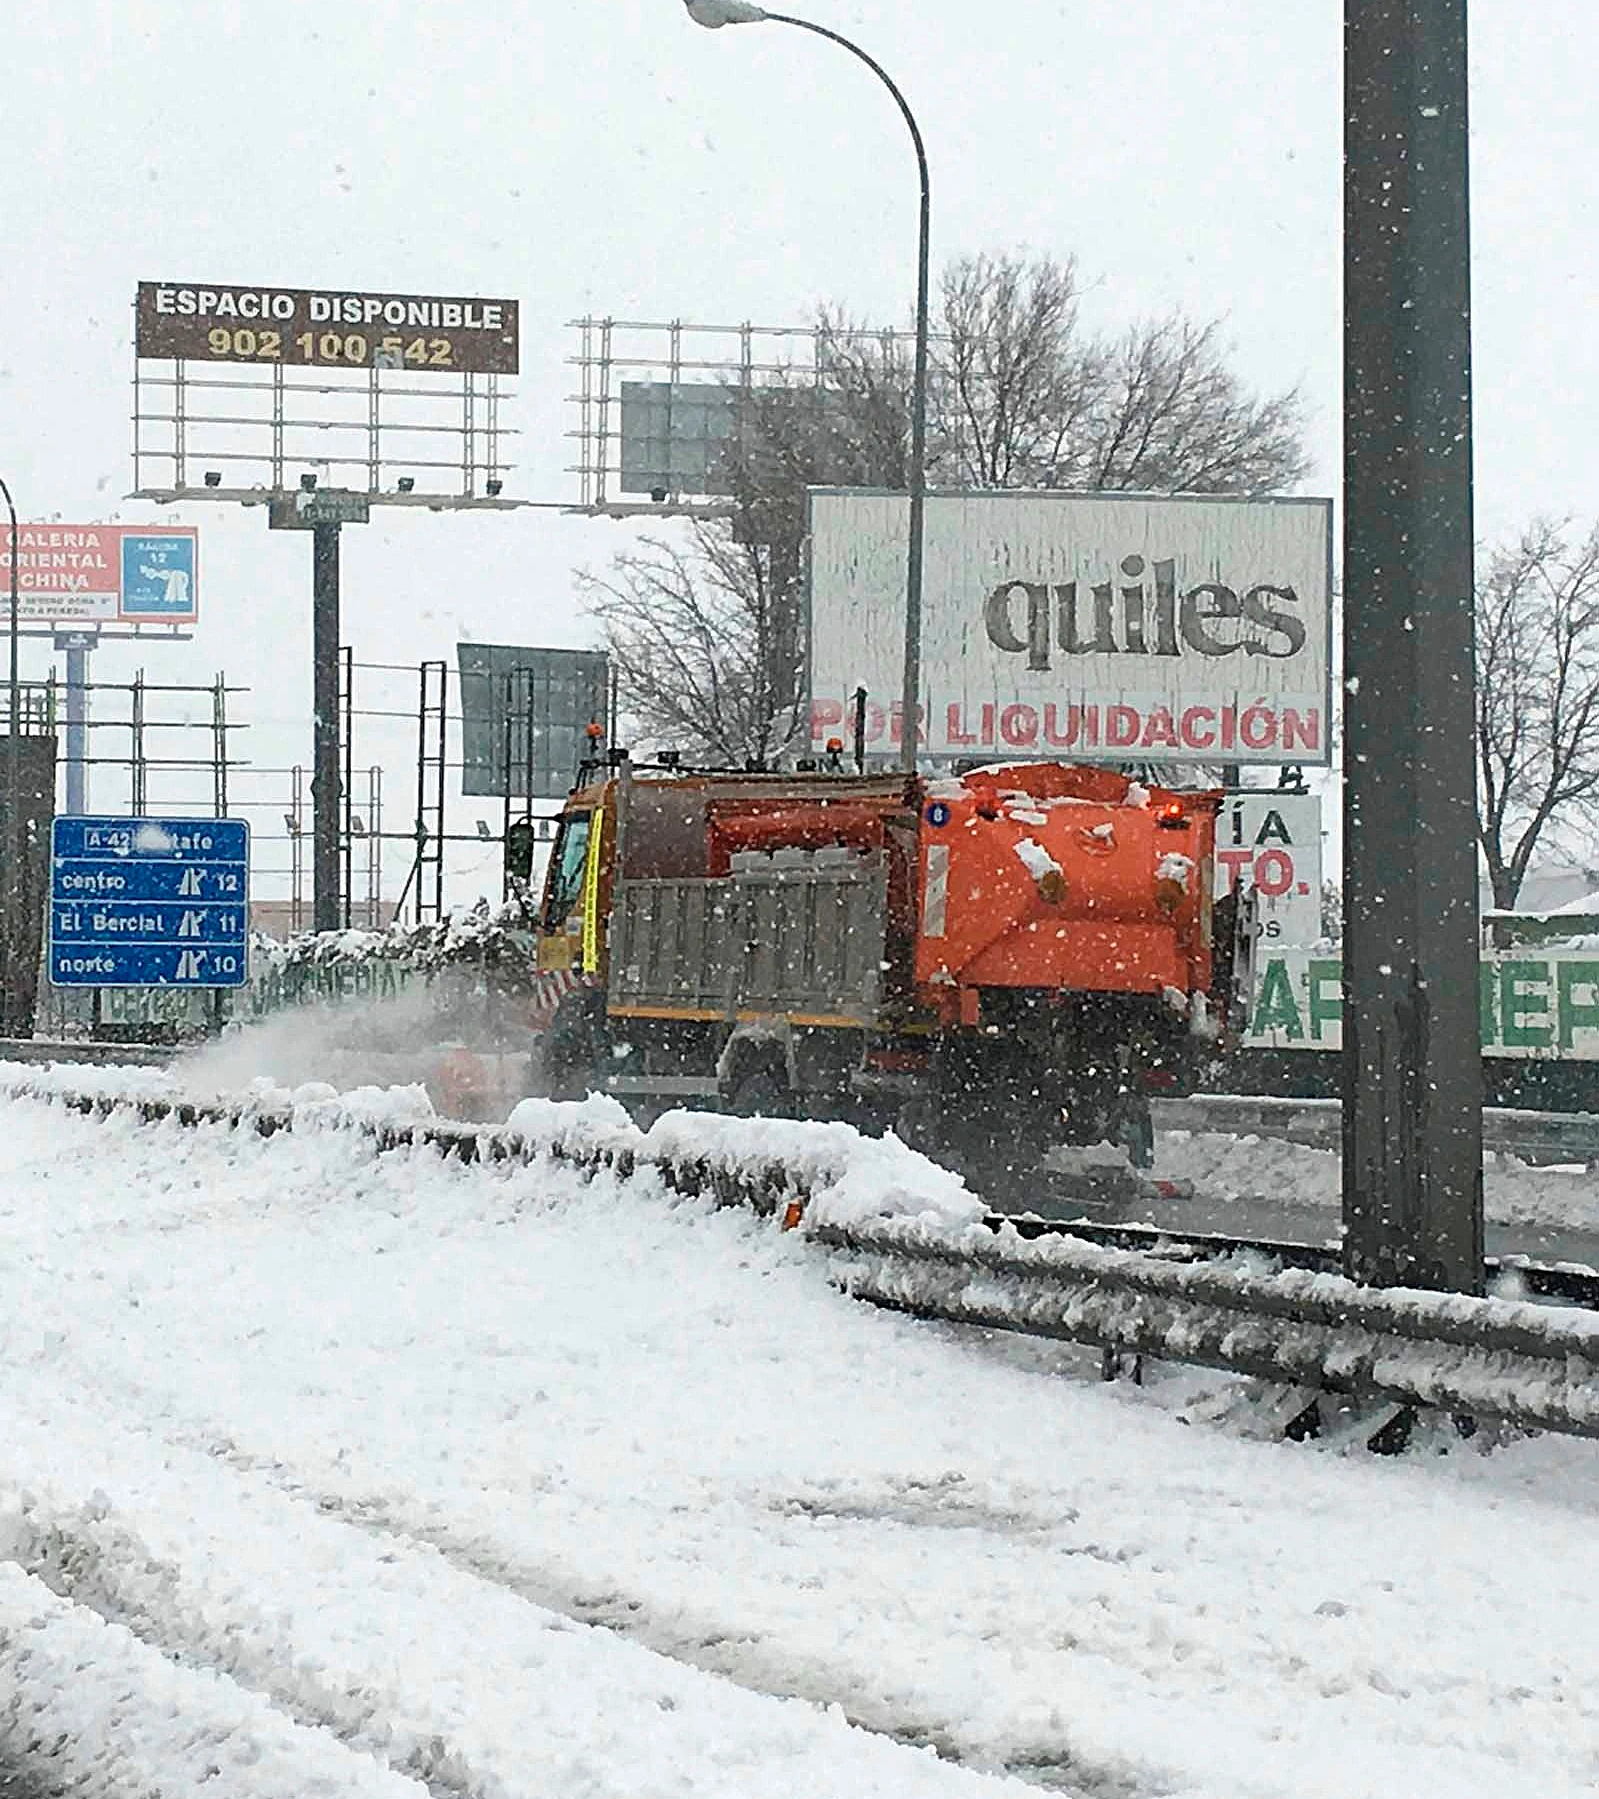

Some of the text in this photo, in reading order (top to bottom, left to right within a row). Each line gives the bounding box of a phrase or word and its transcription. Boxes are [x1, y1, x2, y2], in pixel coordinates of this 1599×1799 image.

[156, 289, 502, 329] ESPACIO DISPONIBLE
[208, 328, 281, 356] 902
[296, 332, 368, 362] 100
[0, 553, 109, 569] ORIENTAL
[20, 572, 89, 589] CHINA
[986, 555, 1307, 672] quiles
[810, 697, 1320, 751] POR LIQUIDACIÓN
[88, 832, 131, 847] A-42
[62, 872, 126, 890] centro
[216, 874, 238, 892] 12
[60, 913, 164, 931] El Bercial
[220, 915, 237, 932] 11
[60, 956, 115, 973] norte
[213, 956, 236, 973] 10
